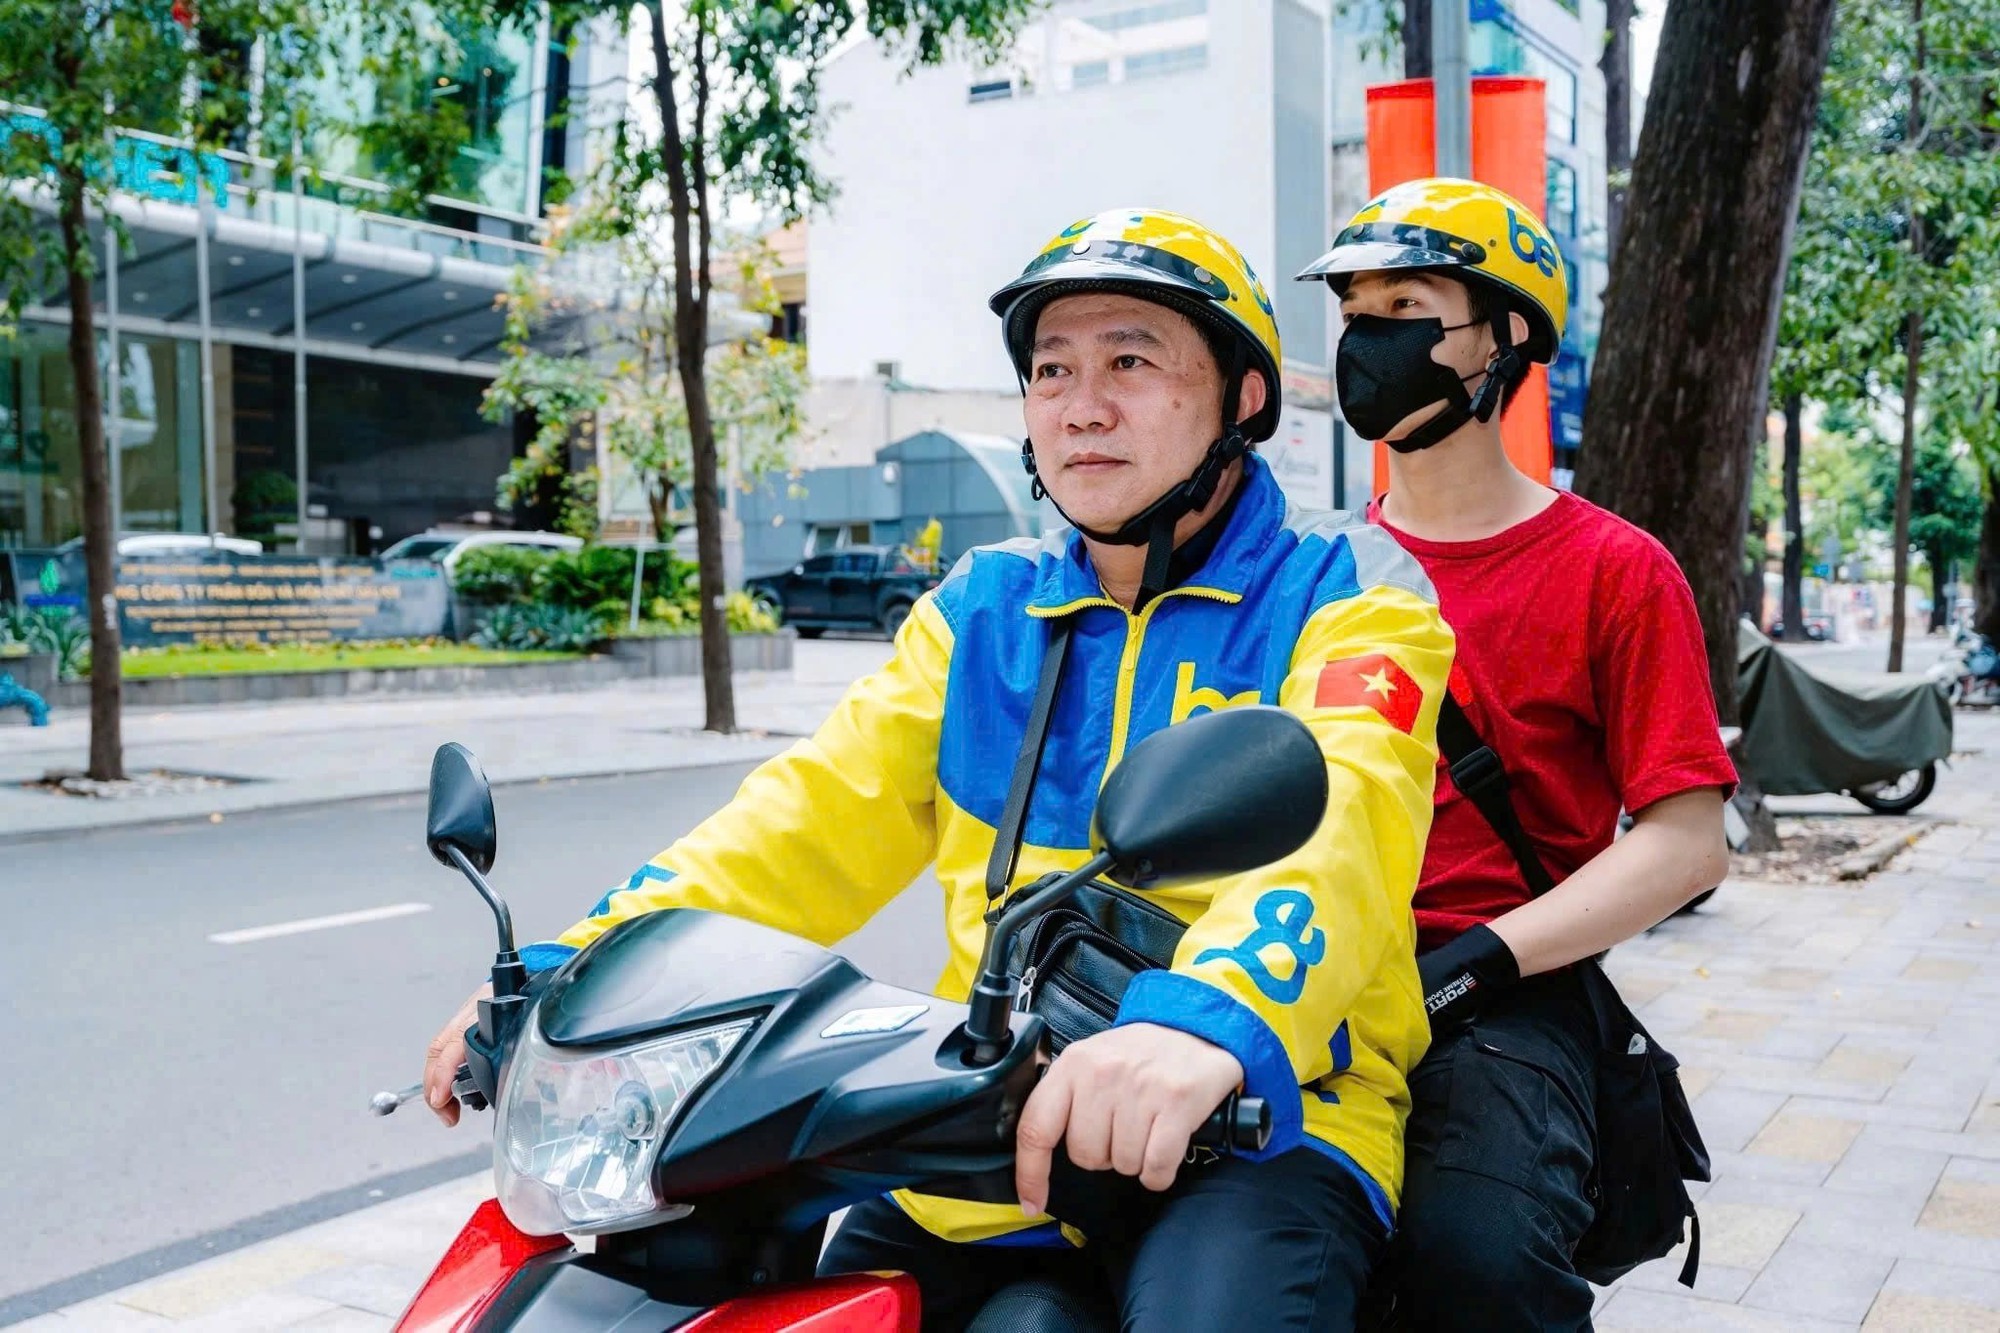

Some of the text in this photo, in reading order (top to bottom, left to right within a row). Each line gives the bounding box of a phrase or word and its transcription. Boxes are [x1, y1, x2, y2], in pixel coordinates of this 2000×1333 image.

[1506, 207, 1558, 278] be
[1170, 661, 1261, 727] b
[1428, 976, 1478, 1015] SPORT
[1443, 971, 1471, 993] EXTREME
